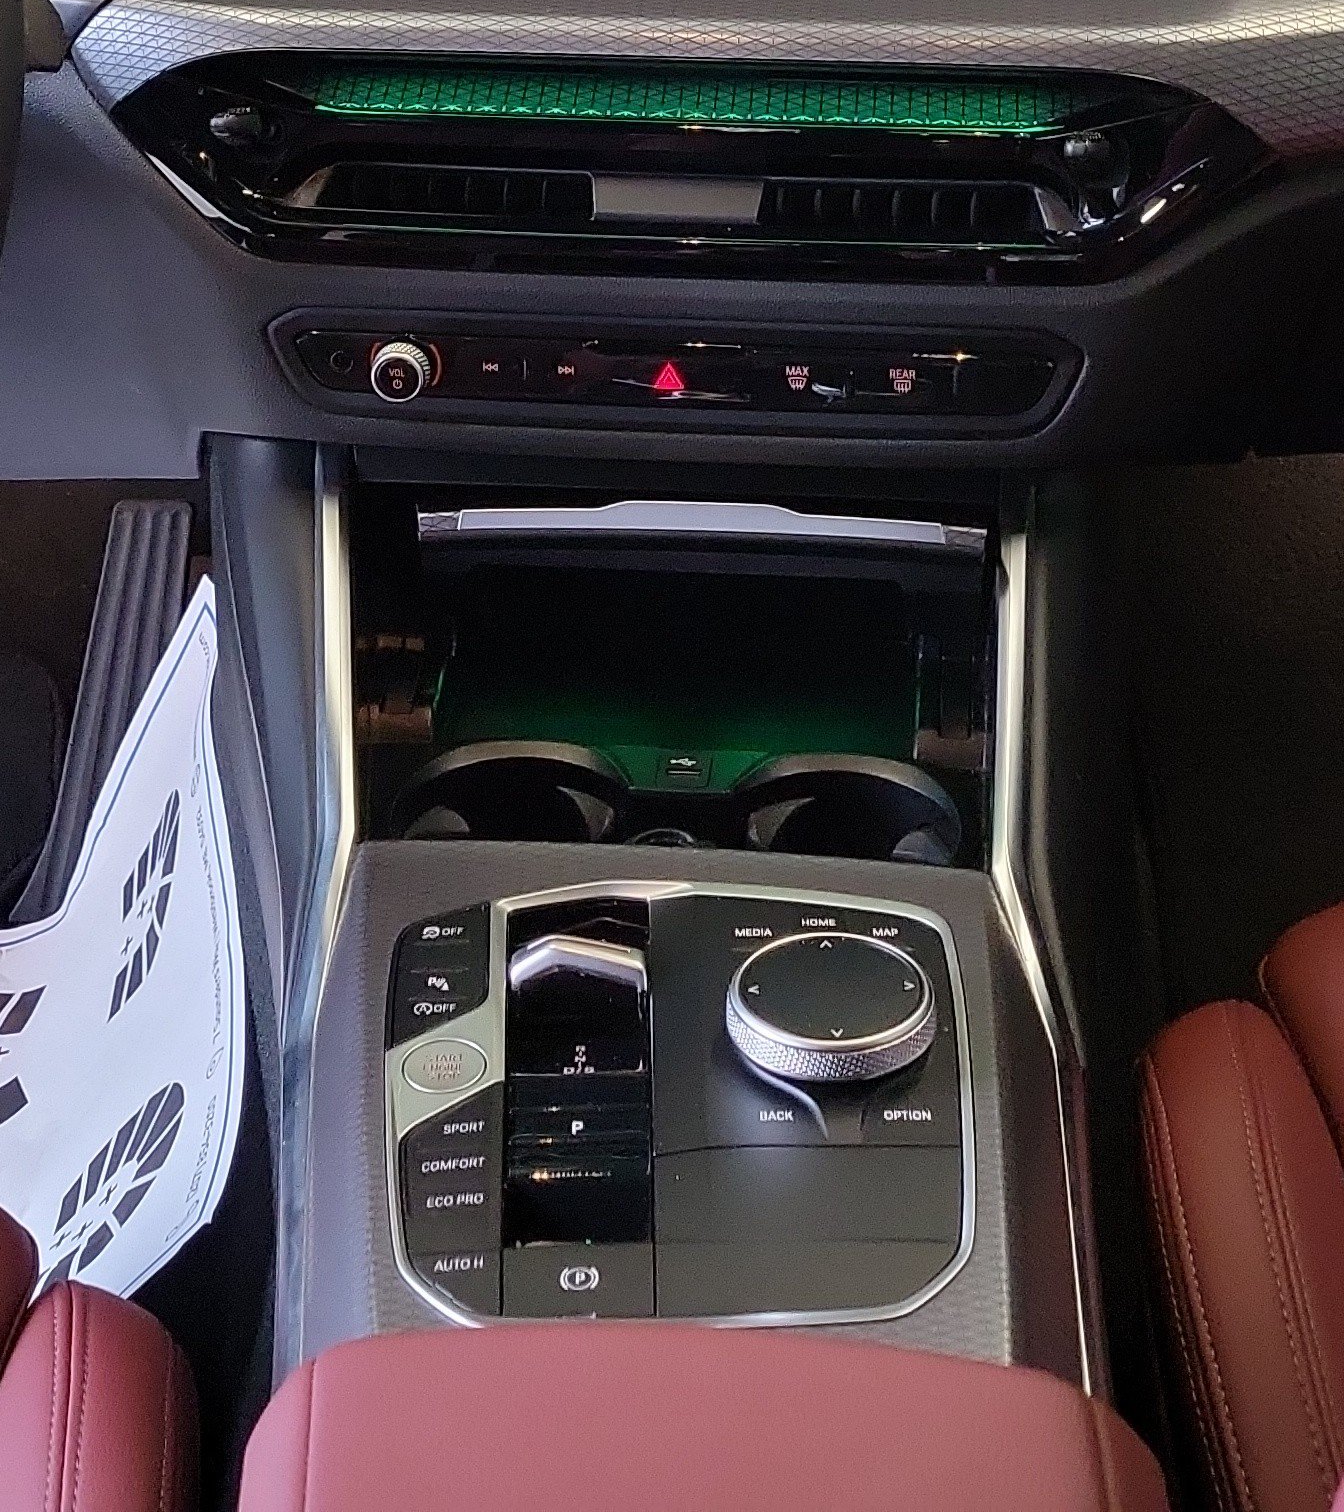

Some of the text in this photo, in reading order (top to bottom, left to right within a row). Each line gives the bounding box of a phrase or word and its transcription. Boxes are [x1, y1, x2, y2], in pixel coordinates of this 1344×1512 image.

[388, 368, 406, 378] VOL
[785, 365, 810, 376] MAX
[889, 368, 916, 380] REAR
[801, 916, 837, 927] HOME
[441, 927, 464, 936] OFF
[734, 926, 773, 938] MEDIA
[872, 926, 898, 938] MAP
[433, 1003, 457, 1013] OFF
[759, 1109, 794, 1122] BACK
[883, 1109, 933, 1122] OPTION
[443, 1120, 485, 1135] SPORT
[421, 1156, 486, 1174] COMFORT
[426, 1192, 485, 1209] ECO PRO
[434, 1254, 484, 1273] AUTO H
